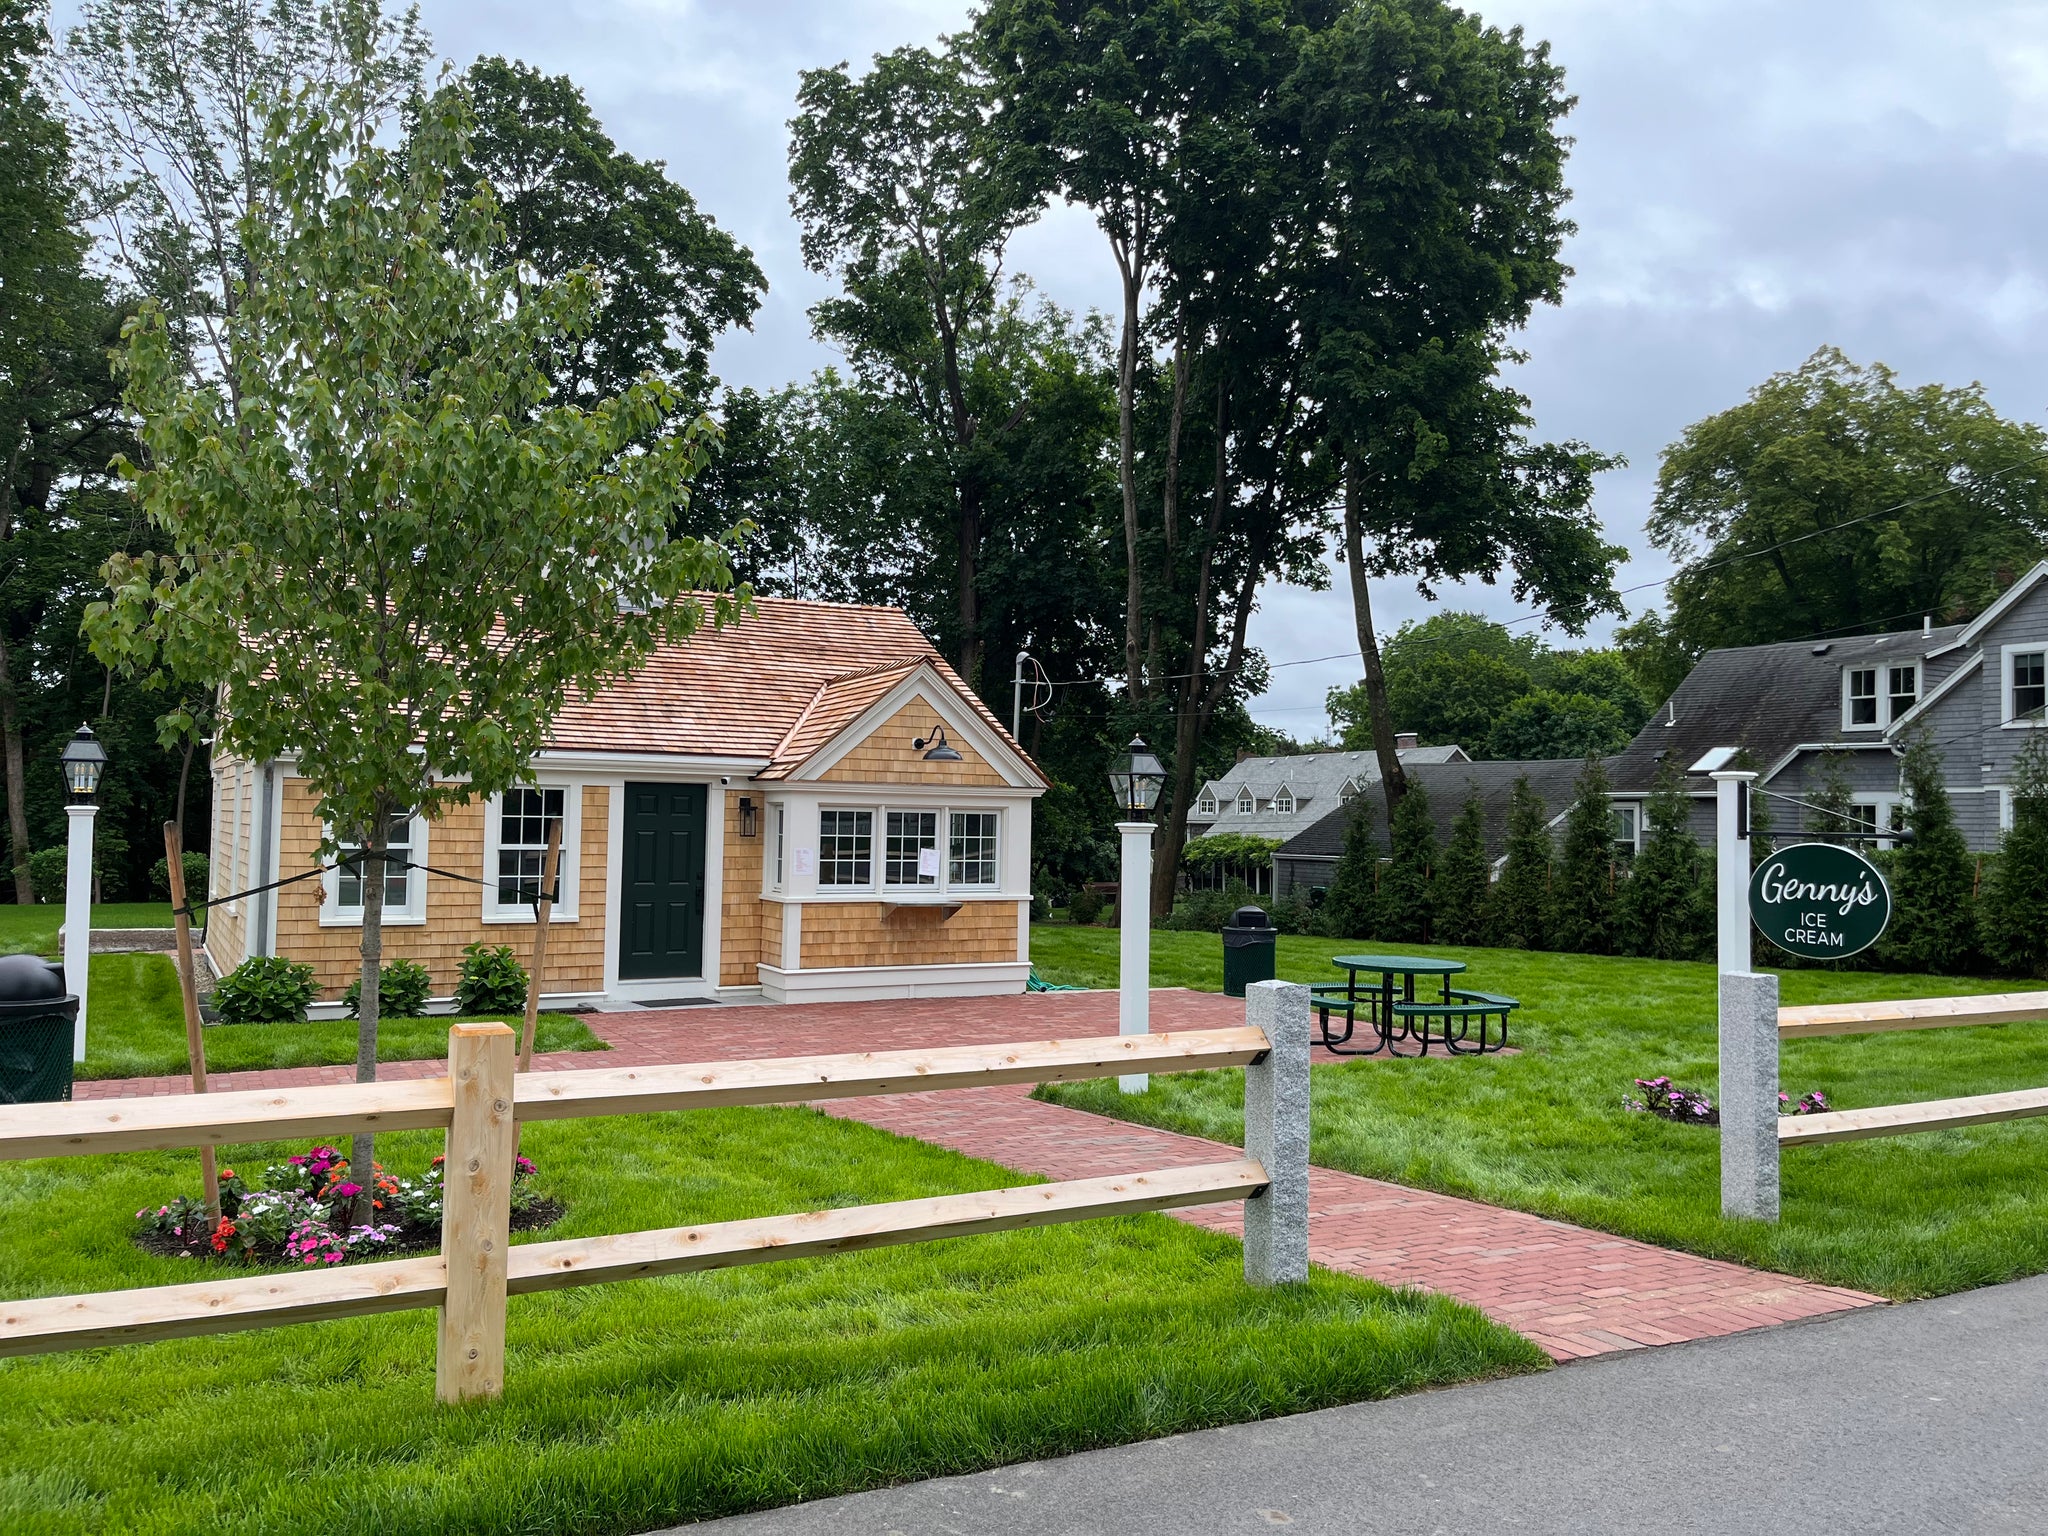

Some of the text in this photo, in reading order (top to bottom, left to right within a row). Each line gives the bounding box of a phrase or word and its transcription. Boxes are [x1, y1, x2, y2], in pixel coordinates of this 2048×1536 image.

[1761, 863, 1878, 916] Genny's
[1800, 912, 1827, 928] ICE
[1784, 928, 1843, 947] CREAM
